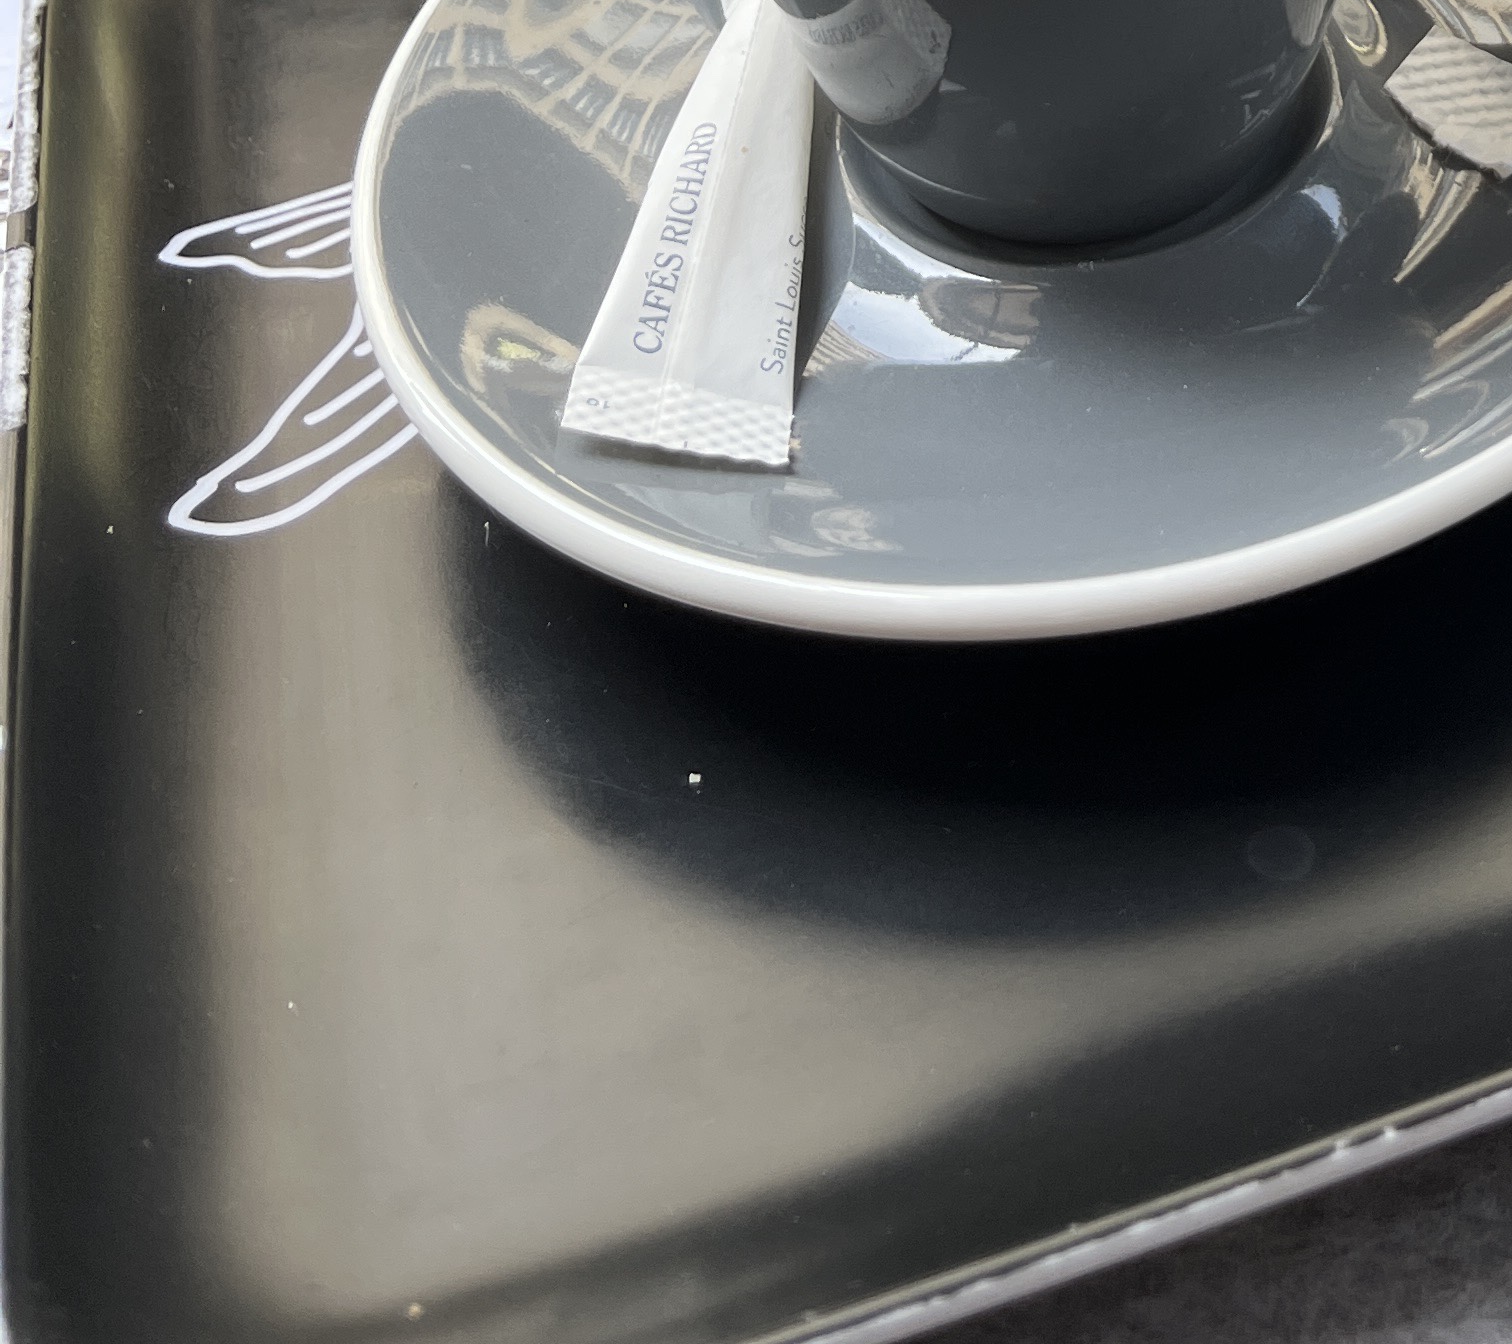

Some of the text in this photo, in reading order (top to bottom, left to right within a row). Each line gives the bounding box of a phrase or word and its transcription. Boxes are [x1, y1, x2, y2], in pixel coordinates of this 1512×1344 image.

[632, 122, 717, 355] CAFÉS RICHARD
[775, 256, 803, 311] Louis
[760, 316, 793, 374] Saint
